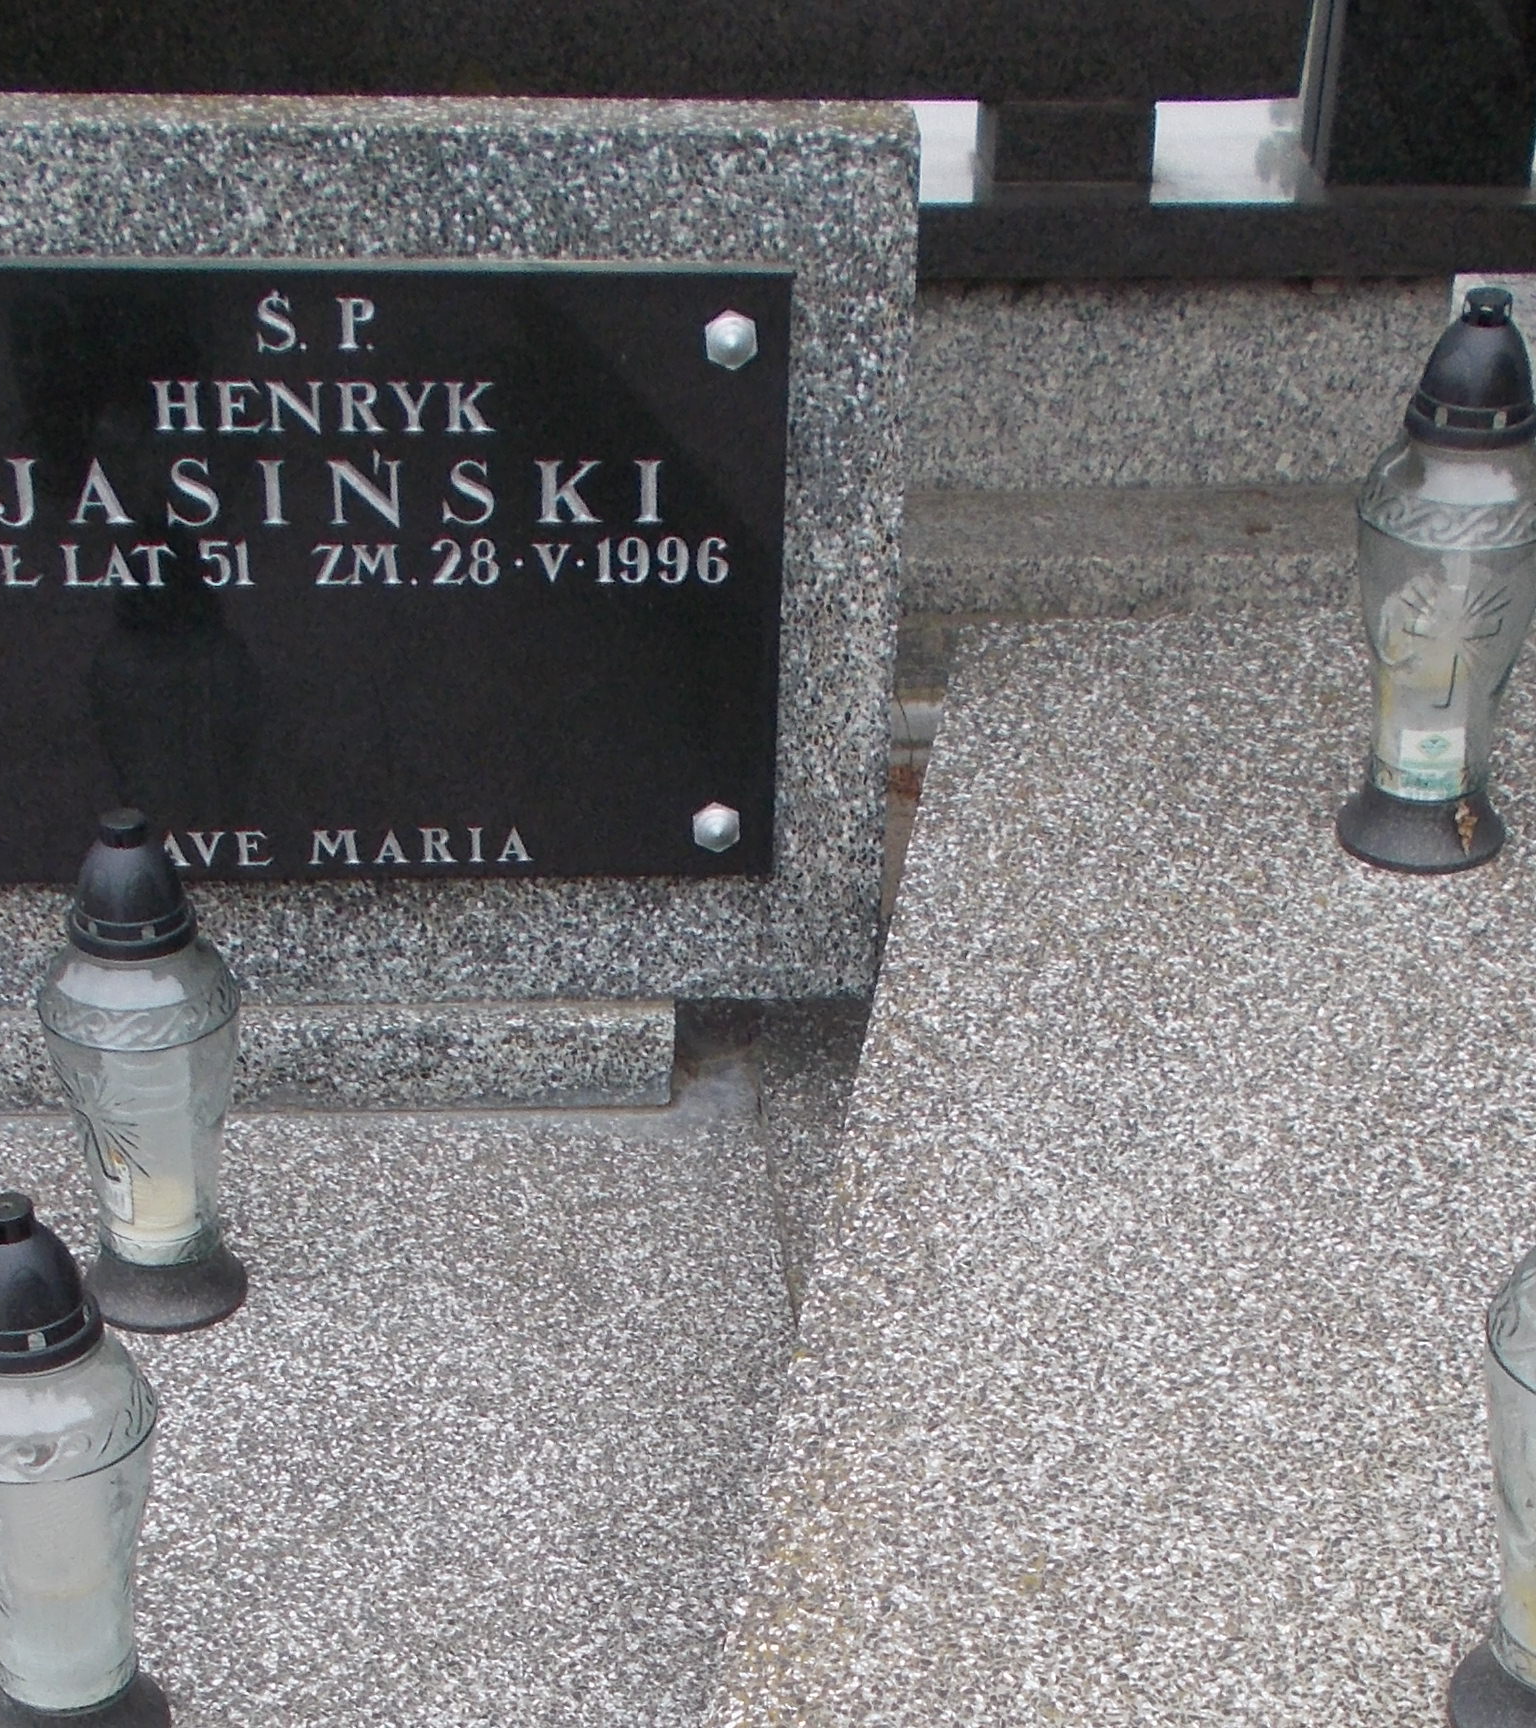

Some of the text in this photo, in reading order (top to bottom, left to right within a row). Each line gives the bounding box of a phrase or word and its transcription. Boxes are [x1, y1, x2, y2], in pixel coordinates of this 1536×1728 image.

[334, 296, 376, 352] P.
[151, 379, 496, 435] HENRYK
[59, 542, 176, 589] LAT
[197, 538, 256, 588] 51
[310, 542, 420, 588] ZM.
[162, 825, 535, 869] AVE MARIA
